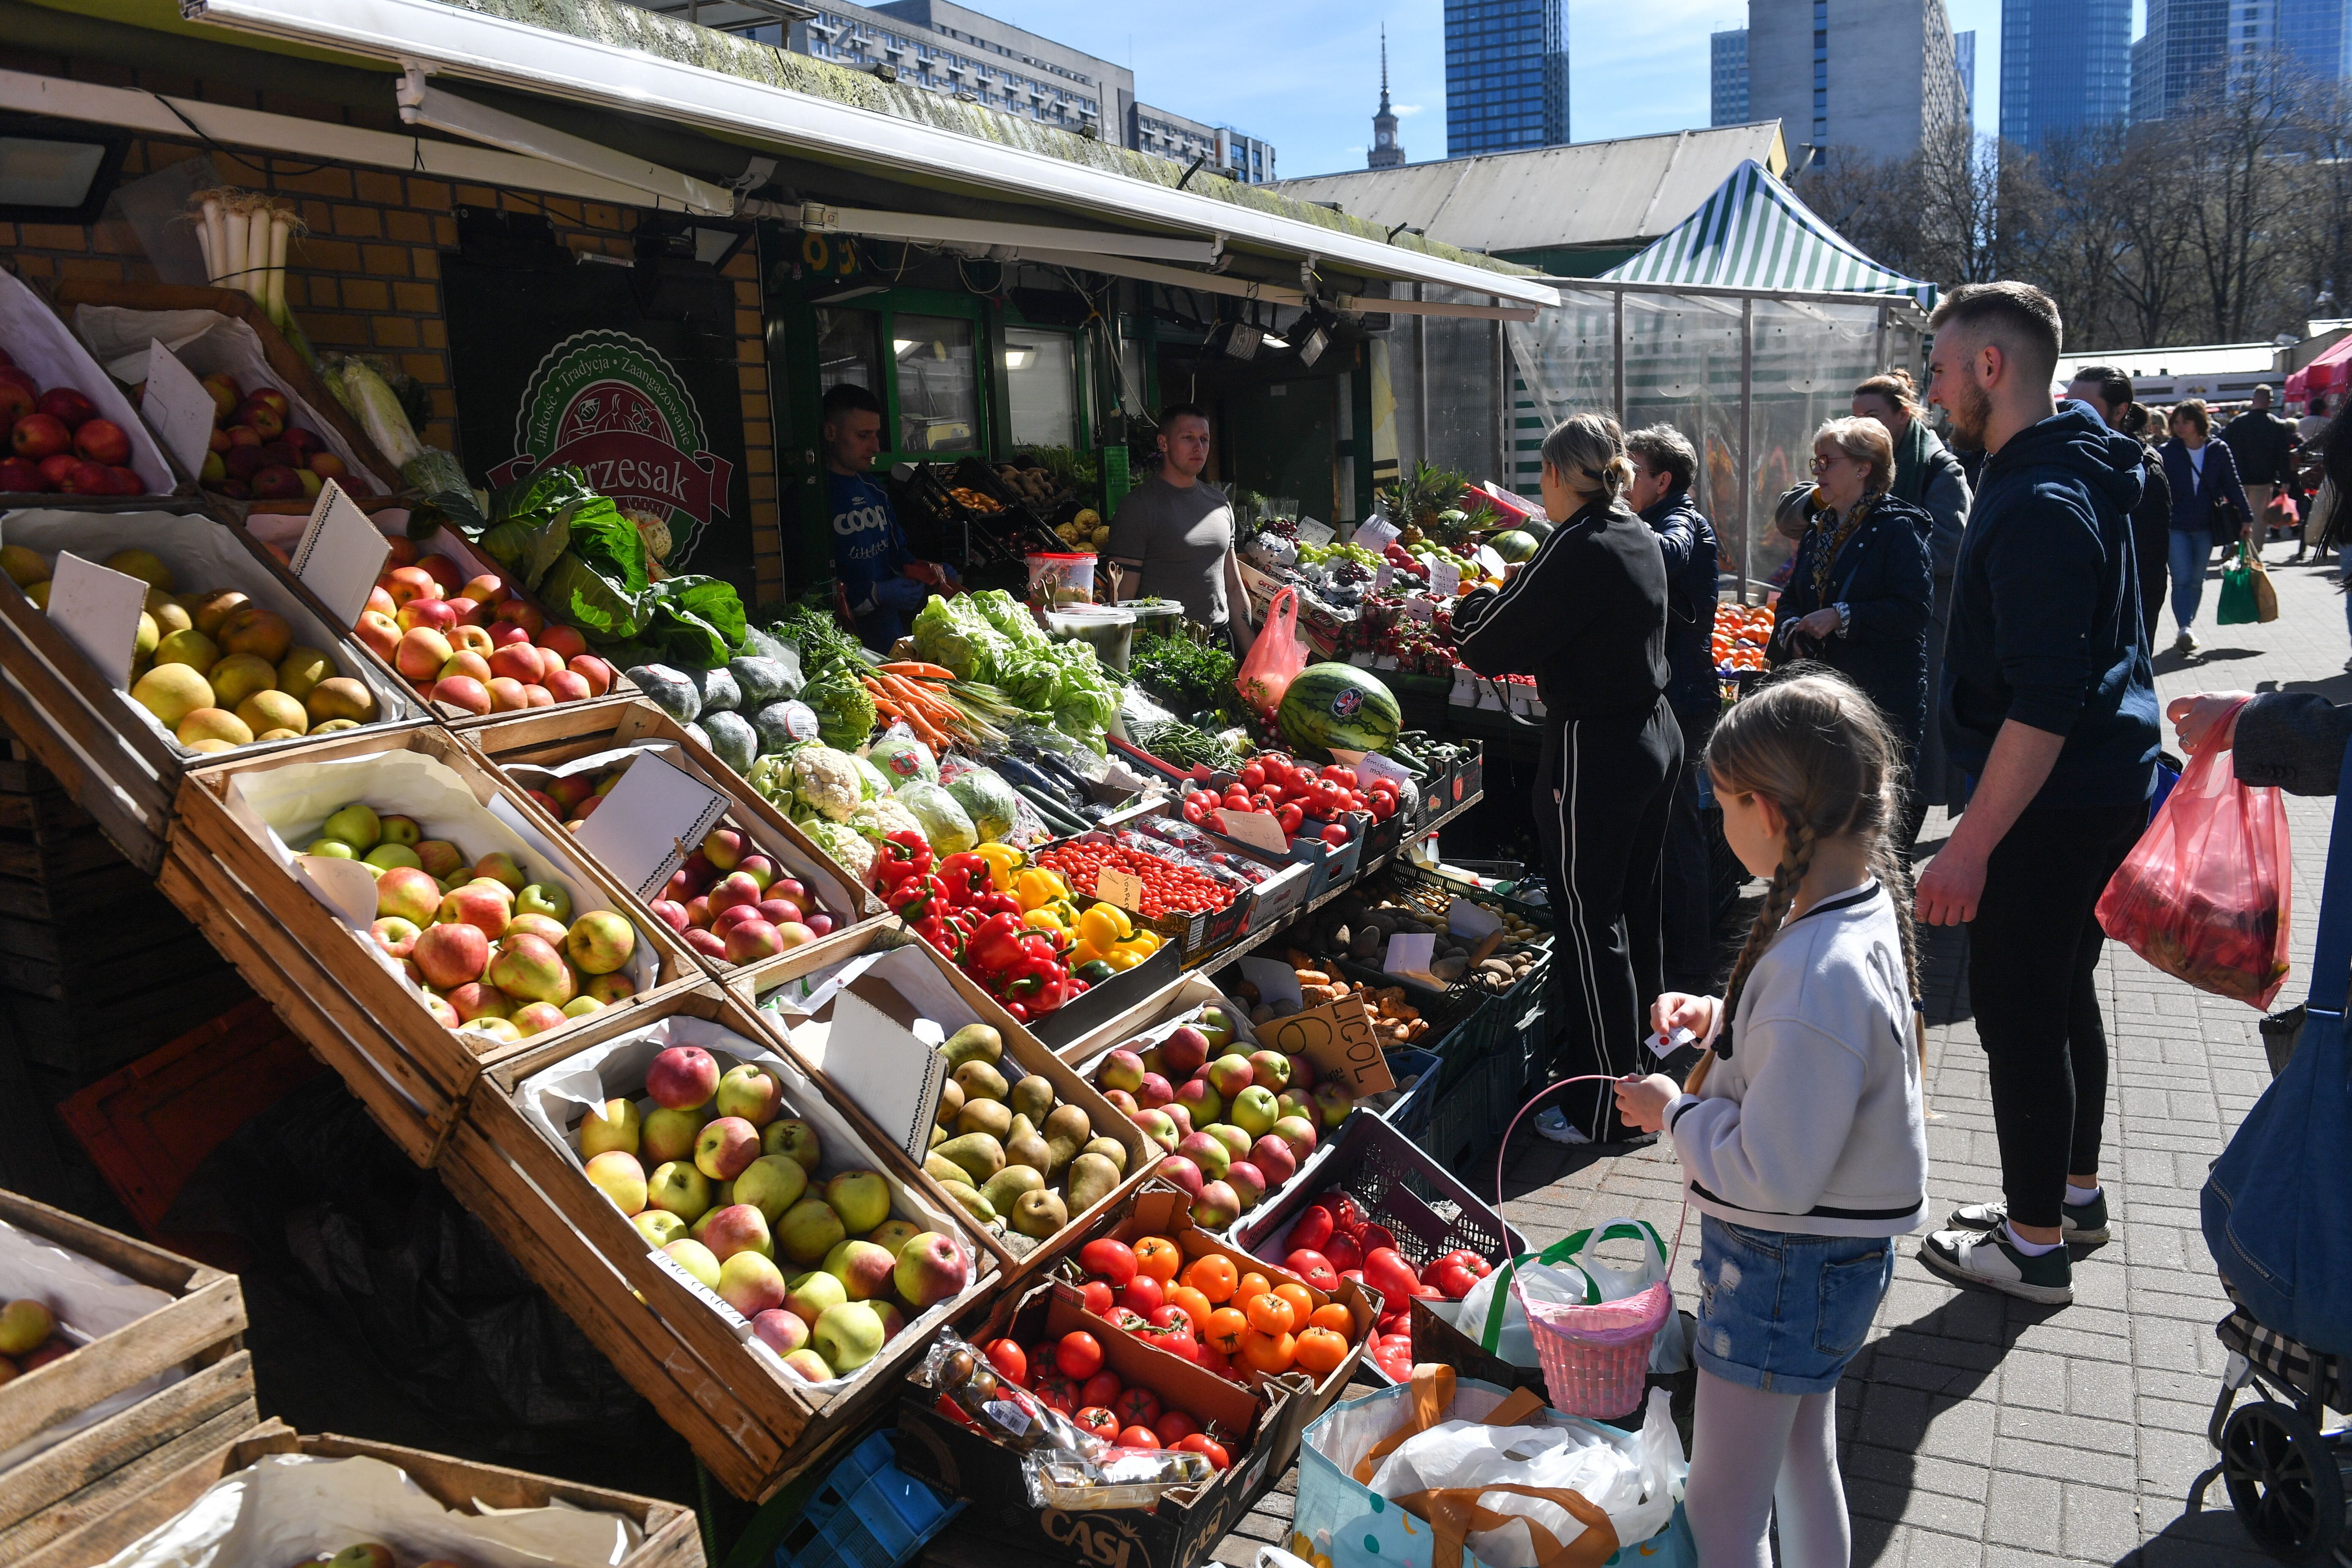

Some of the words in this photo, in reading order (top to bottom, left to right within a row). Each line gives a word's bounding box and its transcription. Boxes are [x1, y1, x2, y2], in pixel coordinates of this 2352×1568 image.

[534, 394, 558, 447] Jakość
[559, 354, 610, 388] Tradycja
[621, 357, 690, 446] Zaangażowanie
[563, 459, 690, 502] rzesak
[833, 505, 887, 535] coop
[1313, 611, 1334, 628] Gold
[1363, 751, 1397, 773] Pomidor
[1277, 1017, 1333, 1055] 6
[1331, 998, 1380, 1084] LIGOL
[1041, 1508, 1130, 1568] CASI
[1182, 1508, 1222, 1568] CASI
